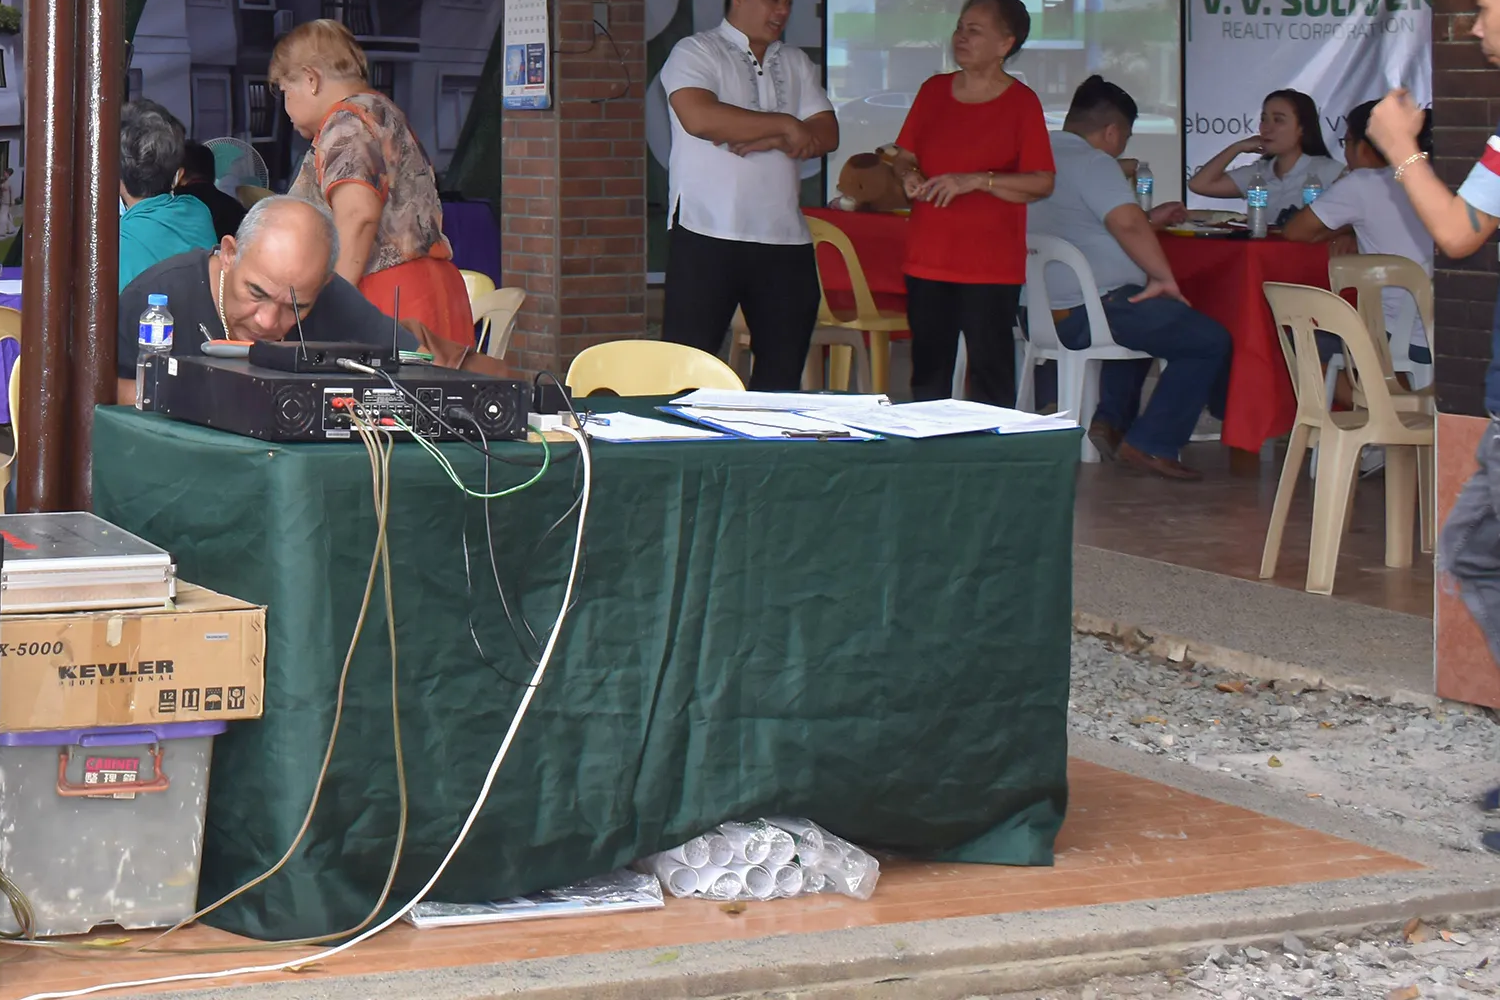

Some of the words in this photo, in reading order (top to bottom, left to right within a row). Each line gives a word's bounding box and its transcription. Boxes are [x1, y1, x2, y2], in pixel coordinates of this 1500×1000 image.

[1222, 21, 1284, 40] REALTY
[1288, 17, 1415, 41] CORPORATION
[58, 659, 175, 680] KEVLER
[163, 691, 175, 700] 12
